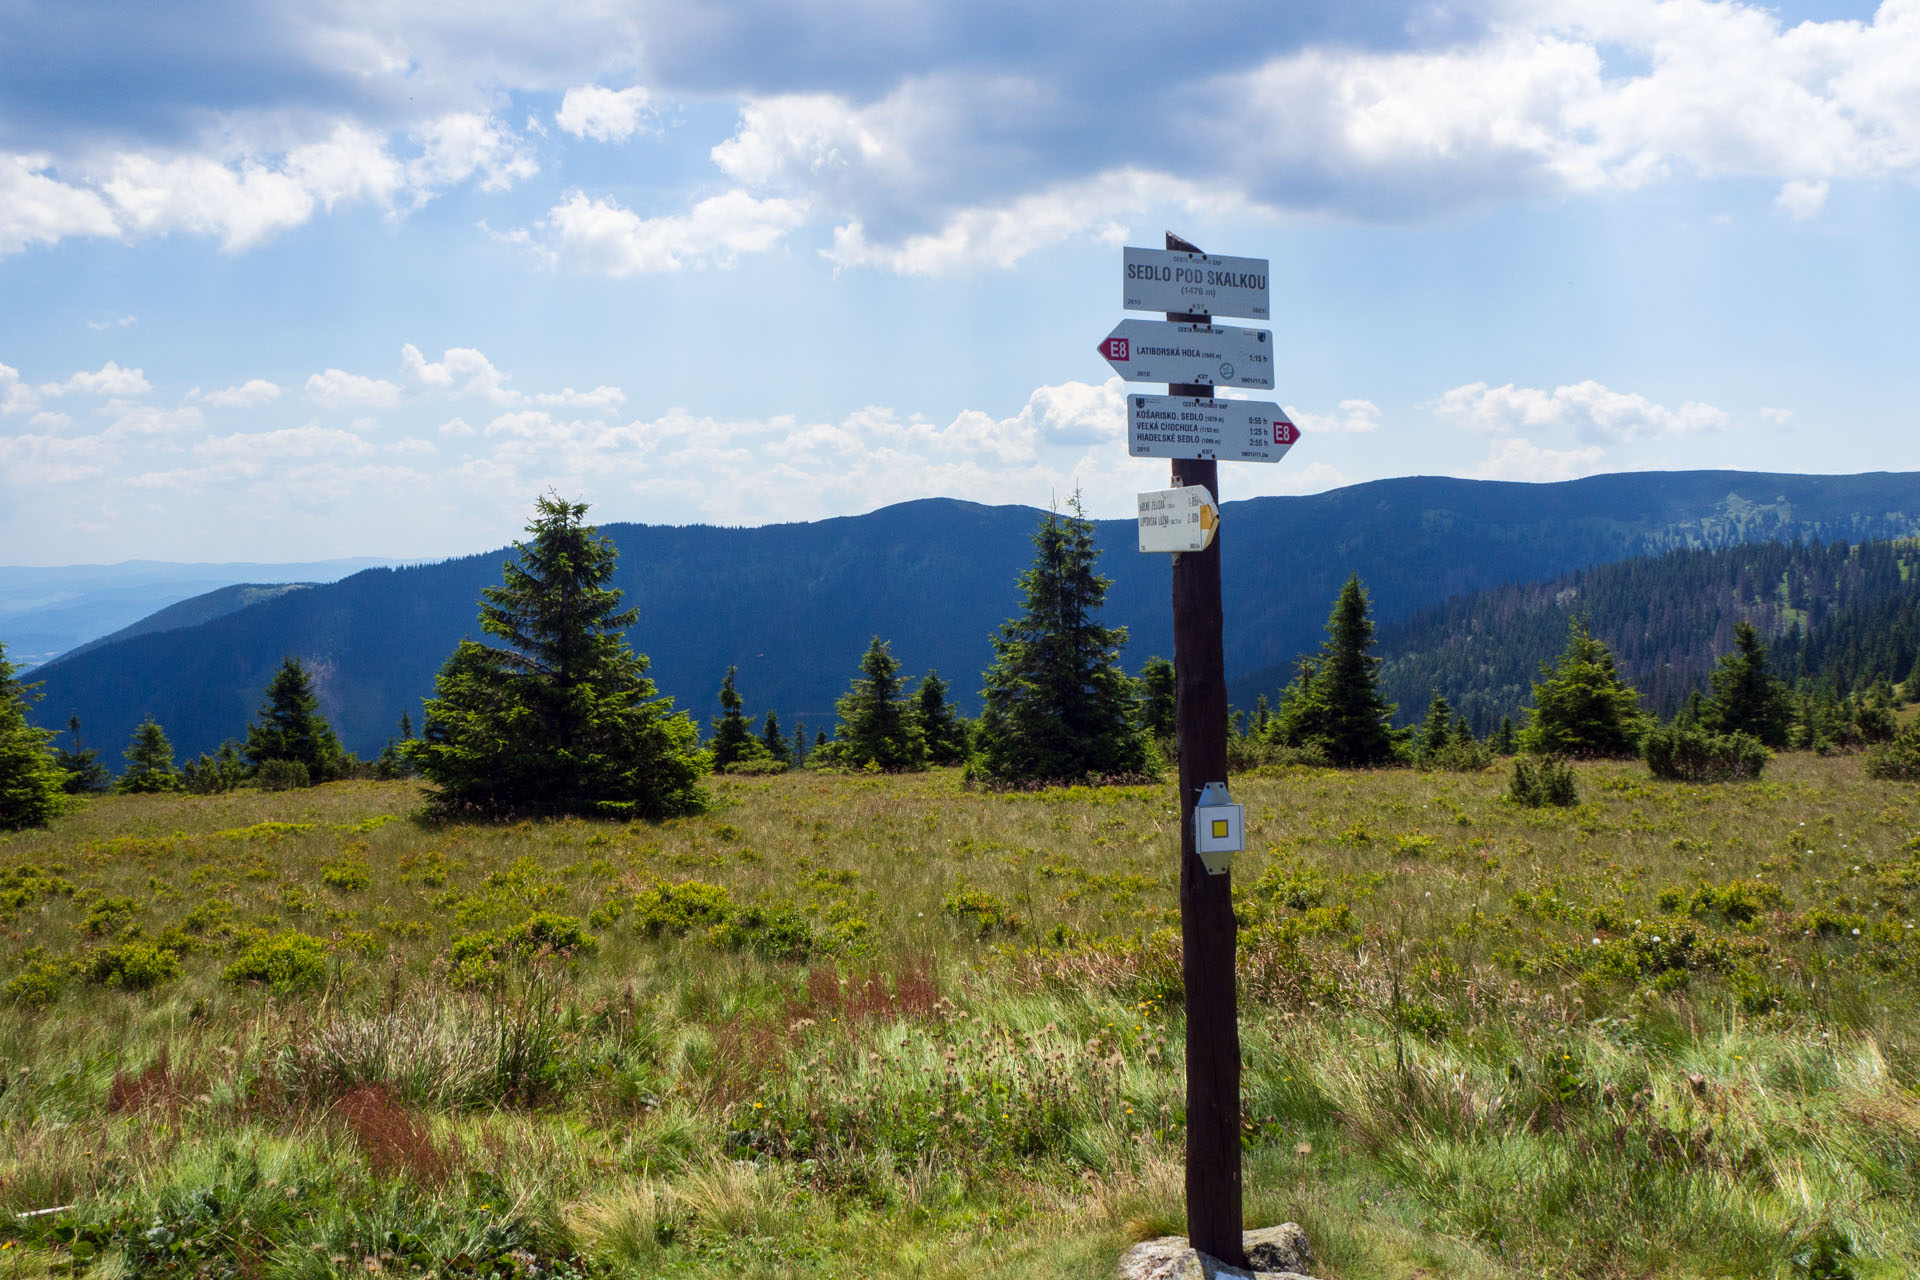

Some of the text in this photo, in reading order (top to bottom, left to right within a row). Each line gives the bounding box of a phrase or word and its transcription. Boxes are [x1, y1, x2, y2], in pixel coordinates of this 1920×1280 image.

[1128, 264, 1266, 290] SEDLO POD SKALKOU
[1110, 340, 1126, 358] E8
[1136, 346, 1180, 356] LATIBORSKÁ
[1250, 354, 1262, 362] 1:15
[1136, 410, 1179, 420] KOŠARISKO,
[1181, 412, 1204, 422] SEDLO
[1250, 428, 1262, 436] 1:25
[1276, 425, 1290, 441] E8
[1177, 435, 1200, 443] SEDLO
